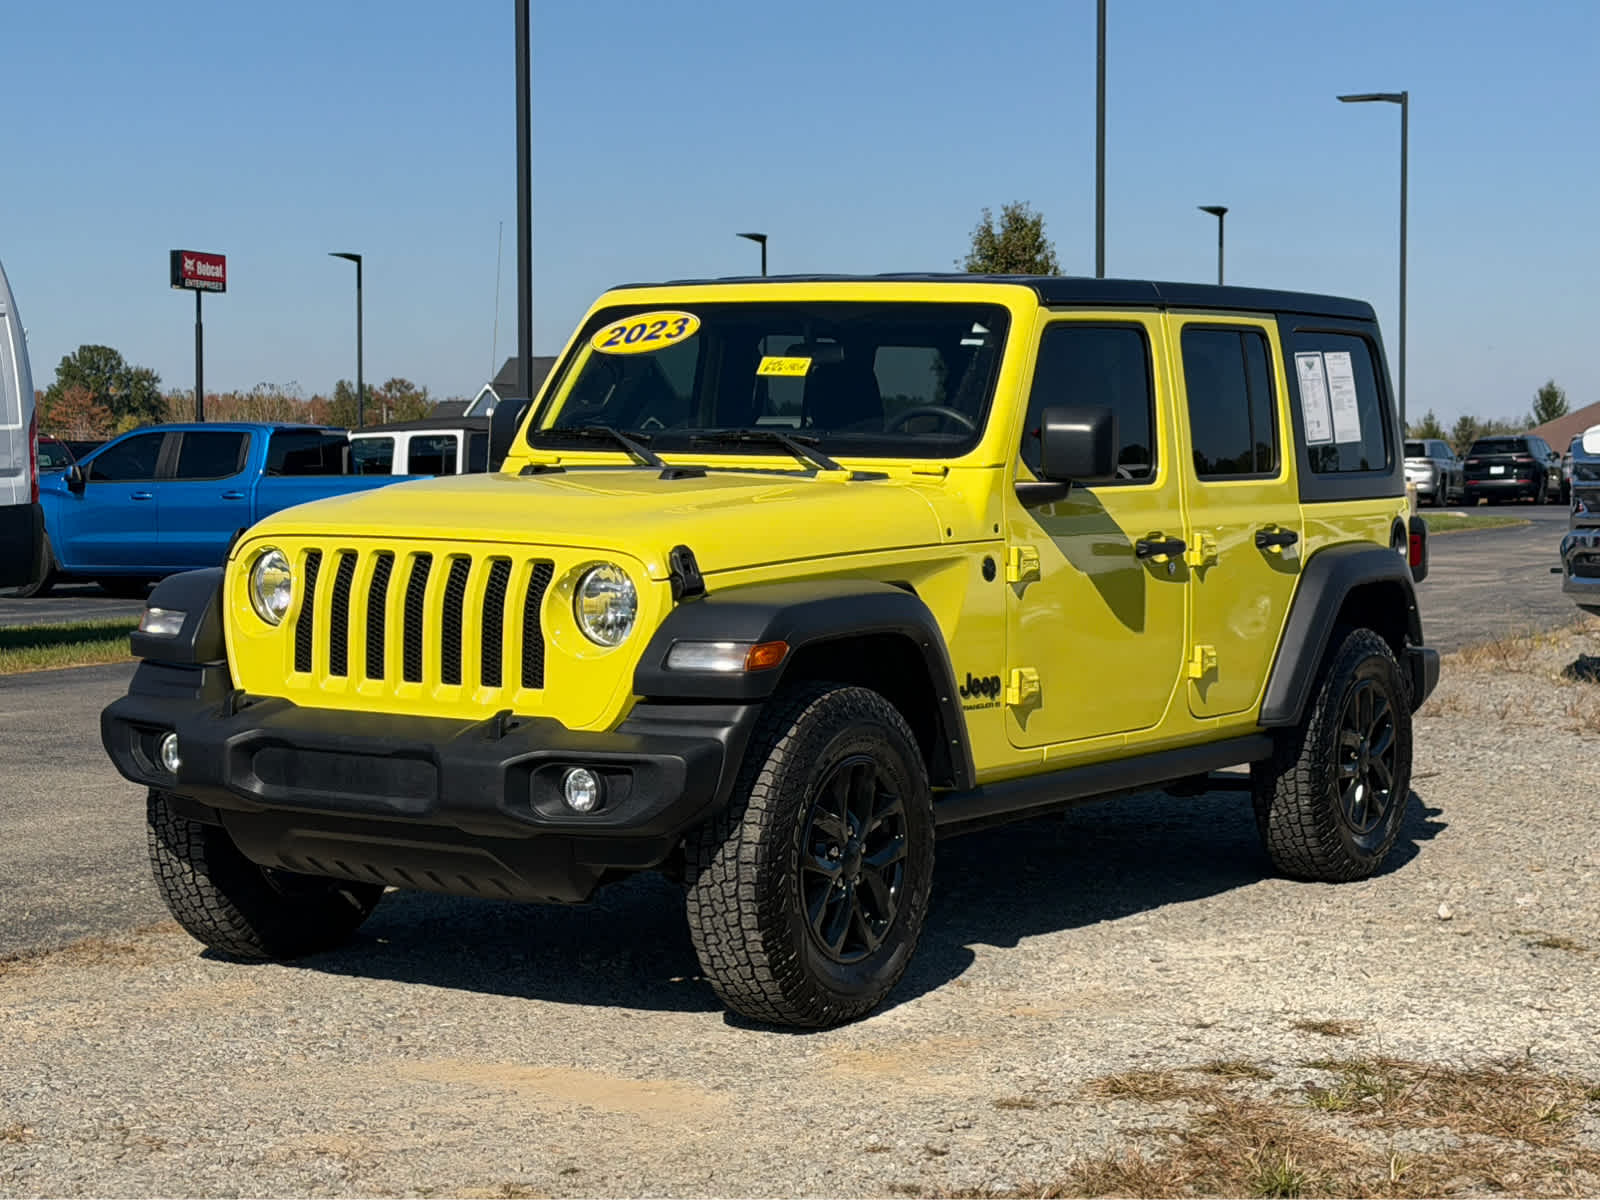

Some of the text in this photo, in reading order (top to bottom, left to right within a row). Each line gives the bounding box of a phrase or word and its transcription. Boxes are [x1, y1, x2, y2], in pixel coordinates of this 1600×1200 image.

[196, 261, 224, 278] Bobcat
[600, 317, 690, 348] 2023
[960, 671, 1001, 701] Jeep
